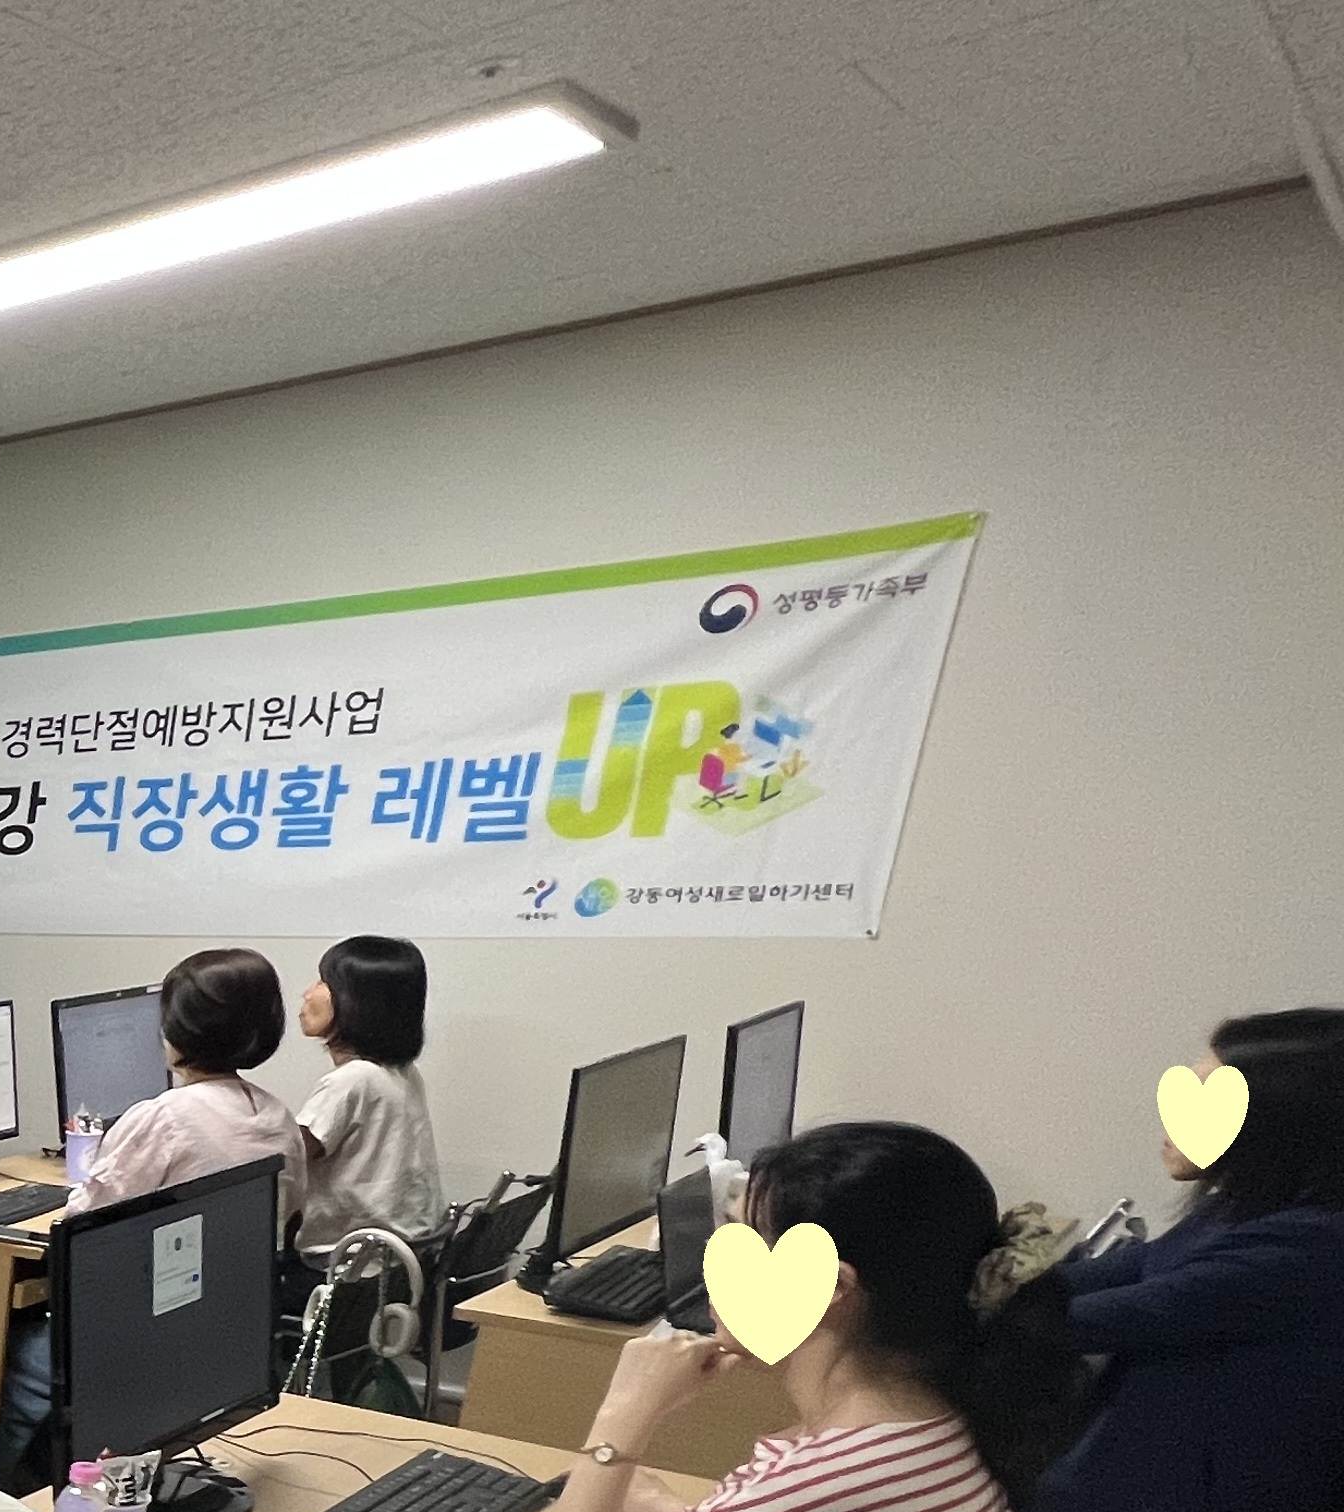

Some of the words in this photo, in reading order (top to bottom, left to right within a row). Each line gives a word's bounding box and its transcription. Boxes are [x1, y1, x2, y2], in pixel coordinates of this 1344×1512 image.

[772, 572, 929, 615] 성평등가족부
[0, 686, 386, 759] 경력단절예방지원사업
[66, 763, 351, 853] 직장생활
